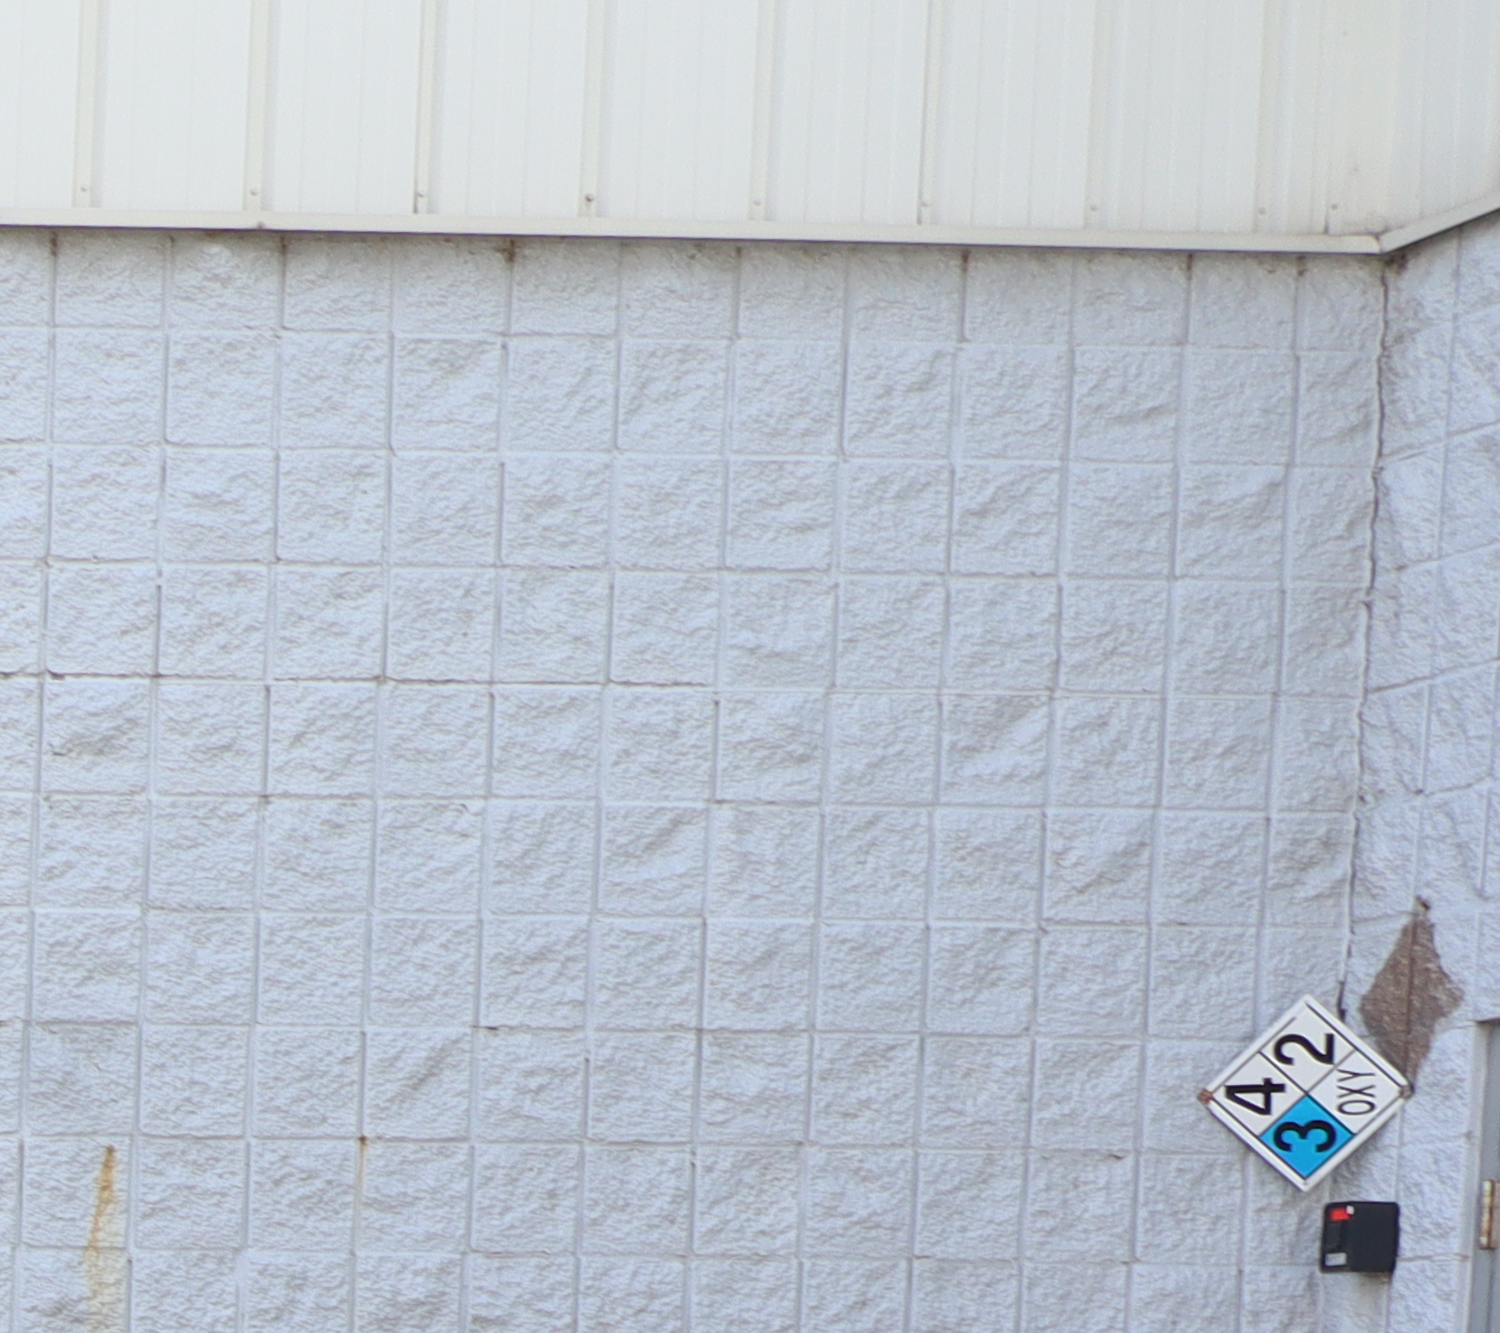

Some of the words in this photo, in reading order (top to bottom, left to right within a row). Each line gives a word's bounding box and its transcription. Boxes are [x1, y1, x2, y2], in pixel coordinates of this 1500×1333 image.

[1273, 1032, 1335, 1065] 2
[1224, 1077, 1286, 1116] 4
[1336, 1068, 1377, 1116] OXY
[1272, 1119, 1337, 1153] 3
